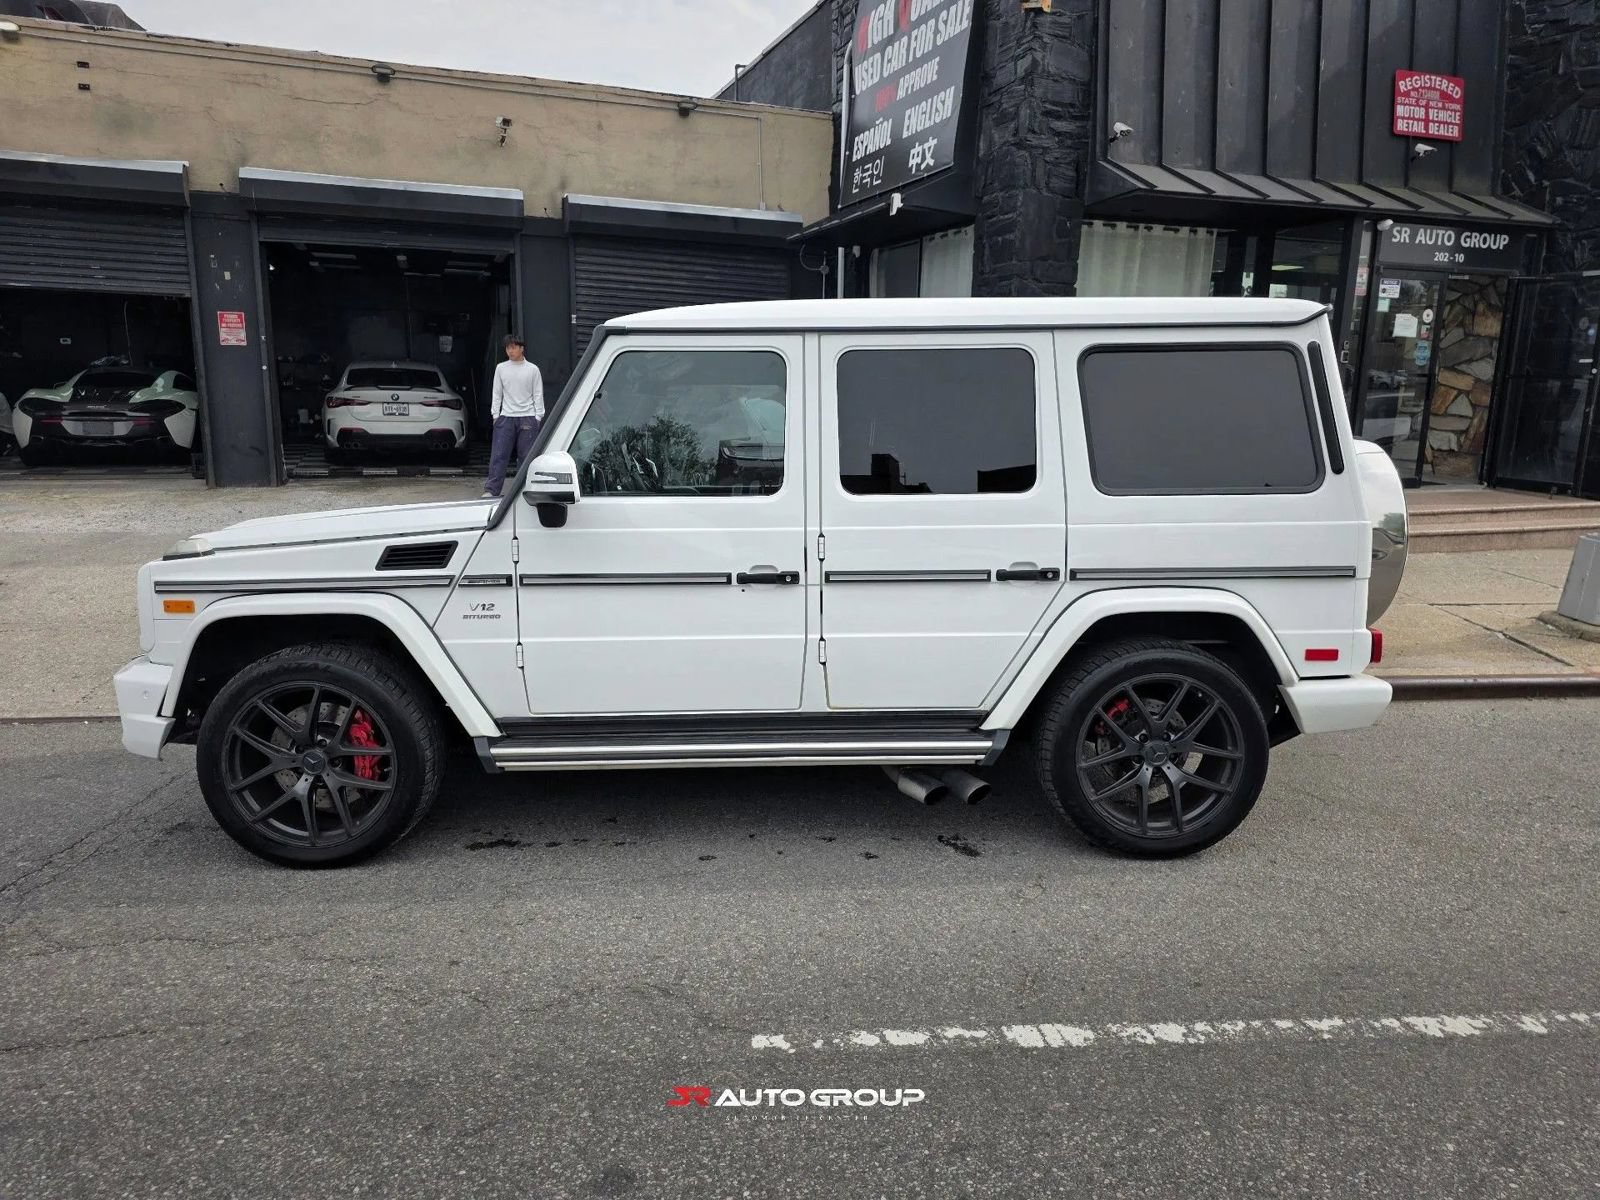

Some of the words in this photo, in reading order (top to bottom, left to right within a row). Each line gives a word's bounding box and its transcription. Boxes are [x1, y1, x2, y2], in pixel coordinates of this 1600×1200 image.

[855, 52, 881, 95] USED
[882, 35, 908, 78] CAR
[909, 18, 935, 63] FOR
[936, 0, 971, 46] SALE
[896, 56, 940, 101] APPROVE
[1399, 75, 1461, 98] REGISTERED
[902, 86, 955, 139] ENGLISH
[1397, 97, 1417, 105] STATE
[1445, 103, 1462, 111] YORK
[1397, 105, 1425, 119] MOTOR
[1429, 108, 1461, 123] VEHICLE
[852, 117, 892, 162] ESPAÑOL
[1397, 119, 1426, 133] RETAIL
[1429, 122, 1459, 137] DEALER
[908, 136, 938, 175] 中文
[852, 155, 885, 194] 한국인
[1392, 226, 1410, 243] SR
[1416, 228, 1455, 246] AUTO
[1460, 232, 1509, 250] GROUP
[470, 603, 495, 612] V12
